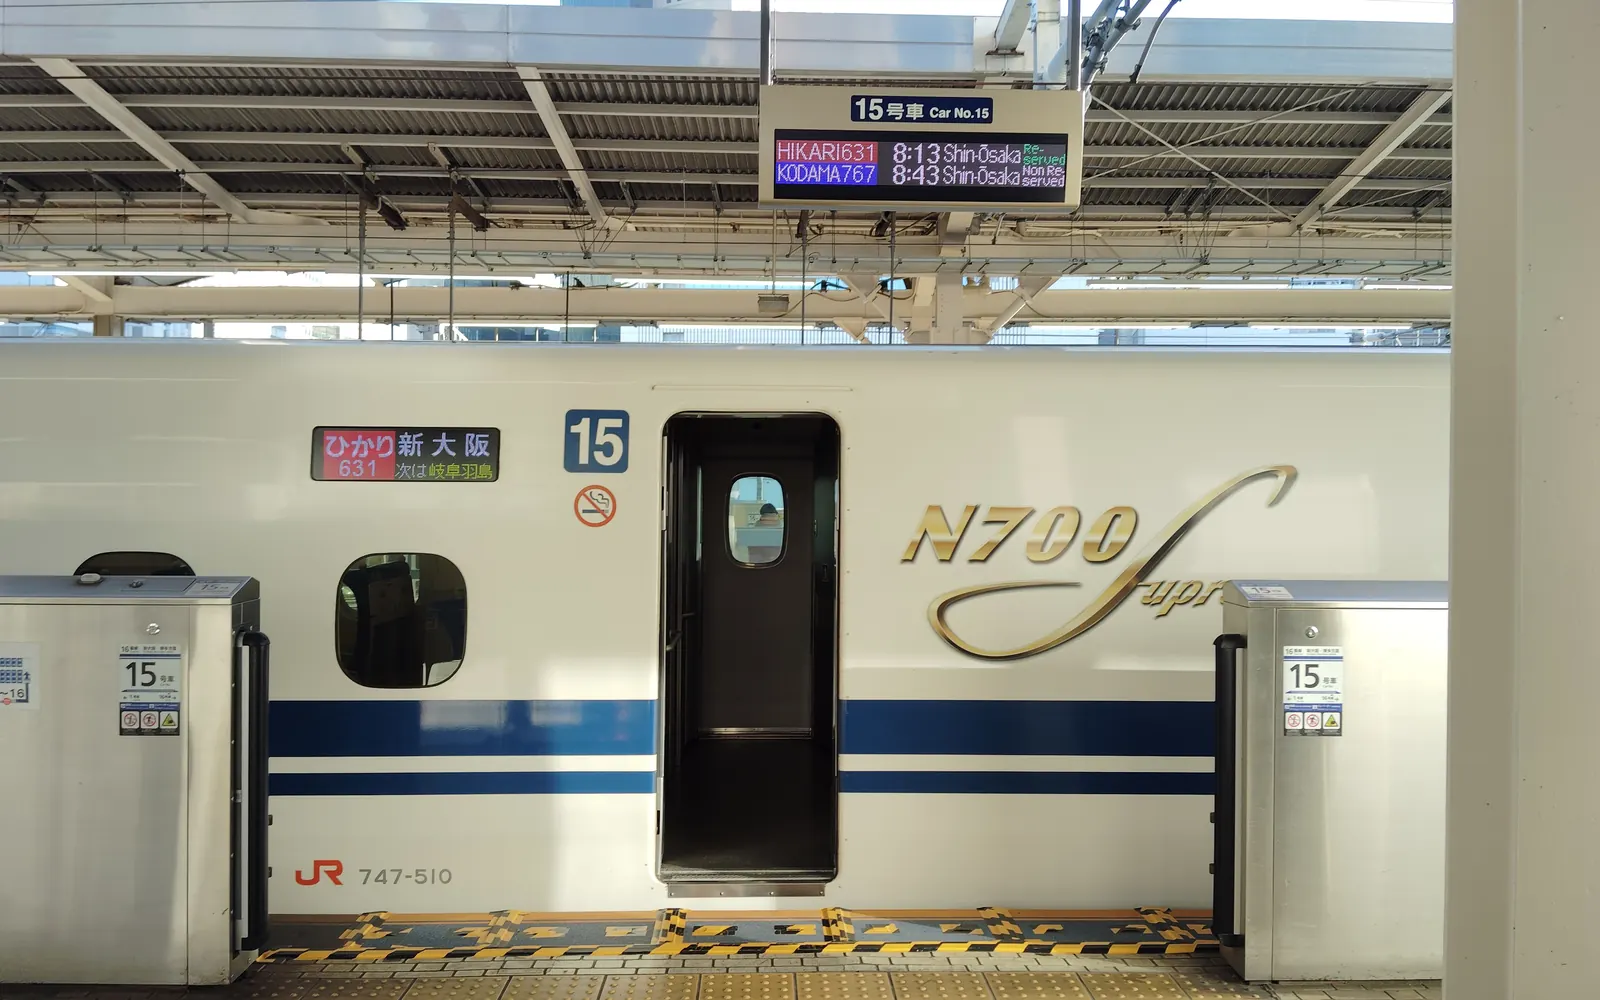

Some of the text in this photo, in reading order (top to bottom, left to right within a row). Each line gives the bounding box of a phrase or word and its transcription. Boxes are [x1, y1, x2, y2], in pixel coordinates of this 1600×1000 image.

[855, 98, 989, 120] 15号車 Car No.15
[778, 142, 874, 161] HIKARI631
[893, 143, 940, 164] 8:13
[1023, 144, 1044, 154] Re-
[1023, 154, 1066, 166] served
[777, 163, 875, 183] KODAMA767
[892, 165, 940, 185] 8:43
[1022, 165, 1045, 176] Non
[1022, 176, 1065, 187] served
[325, 435, 393, 458] ひかり
[398, 432, 490, 457] 新大阪
[570, 417, 624, 466] 15
[339, 459, 376, 477] 631
[900, 504, 1138, 563] N700
[295, 859, 343, 886] JR
[359, 868, 452, 885] 747-510
